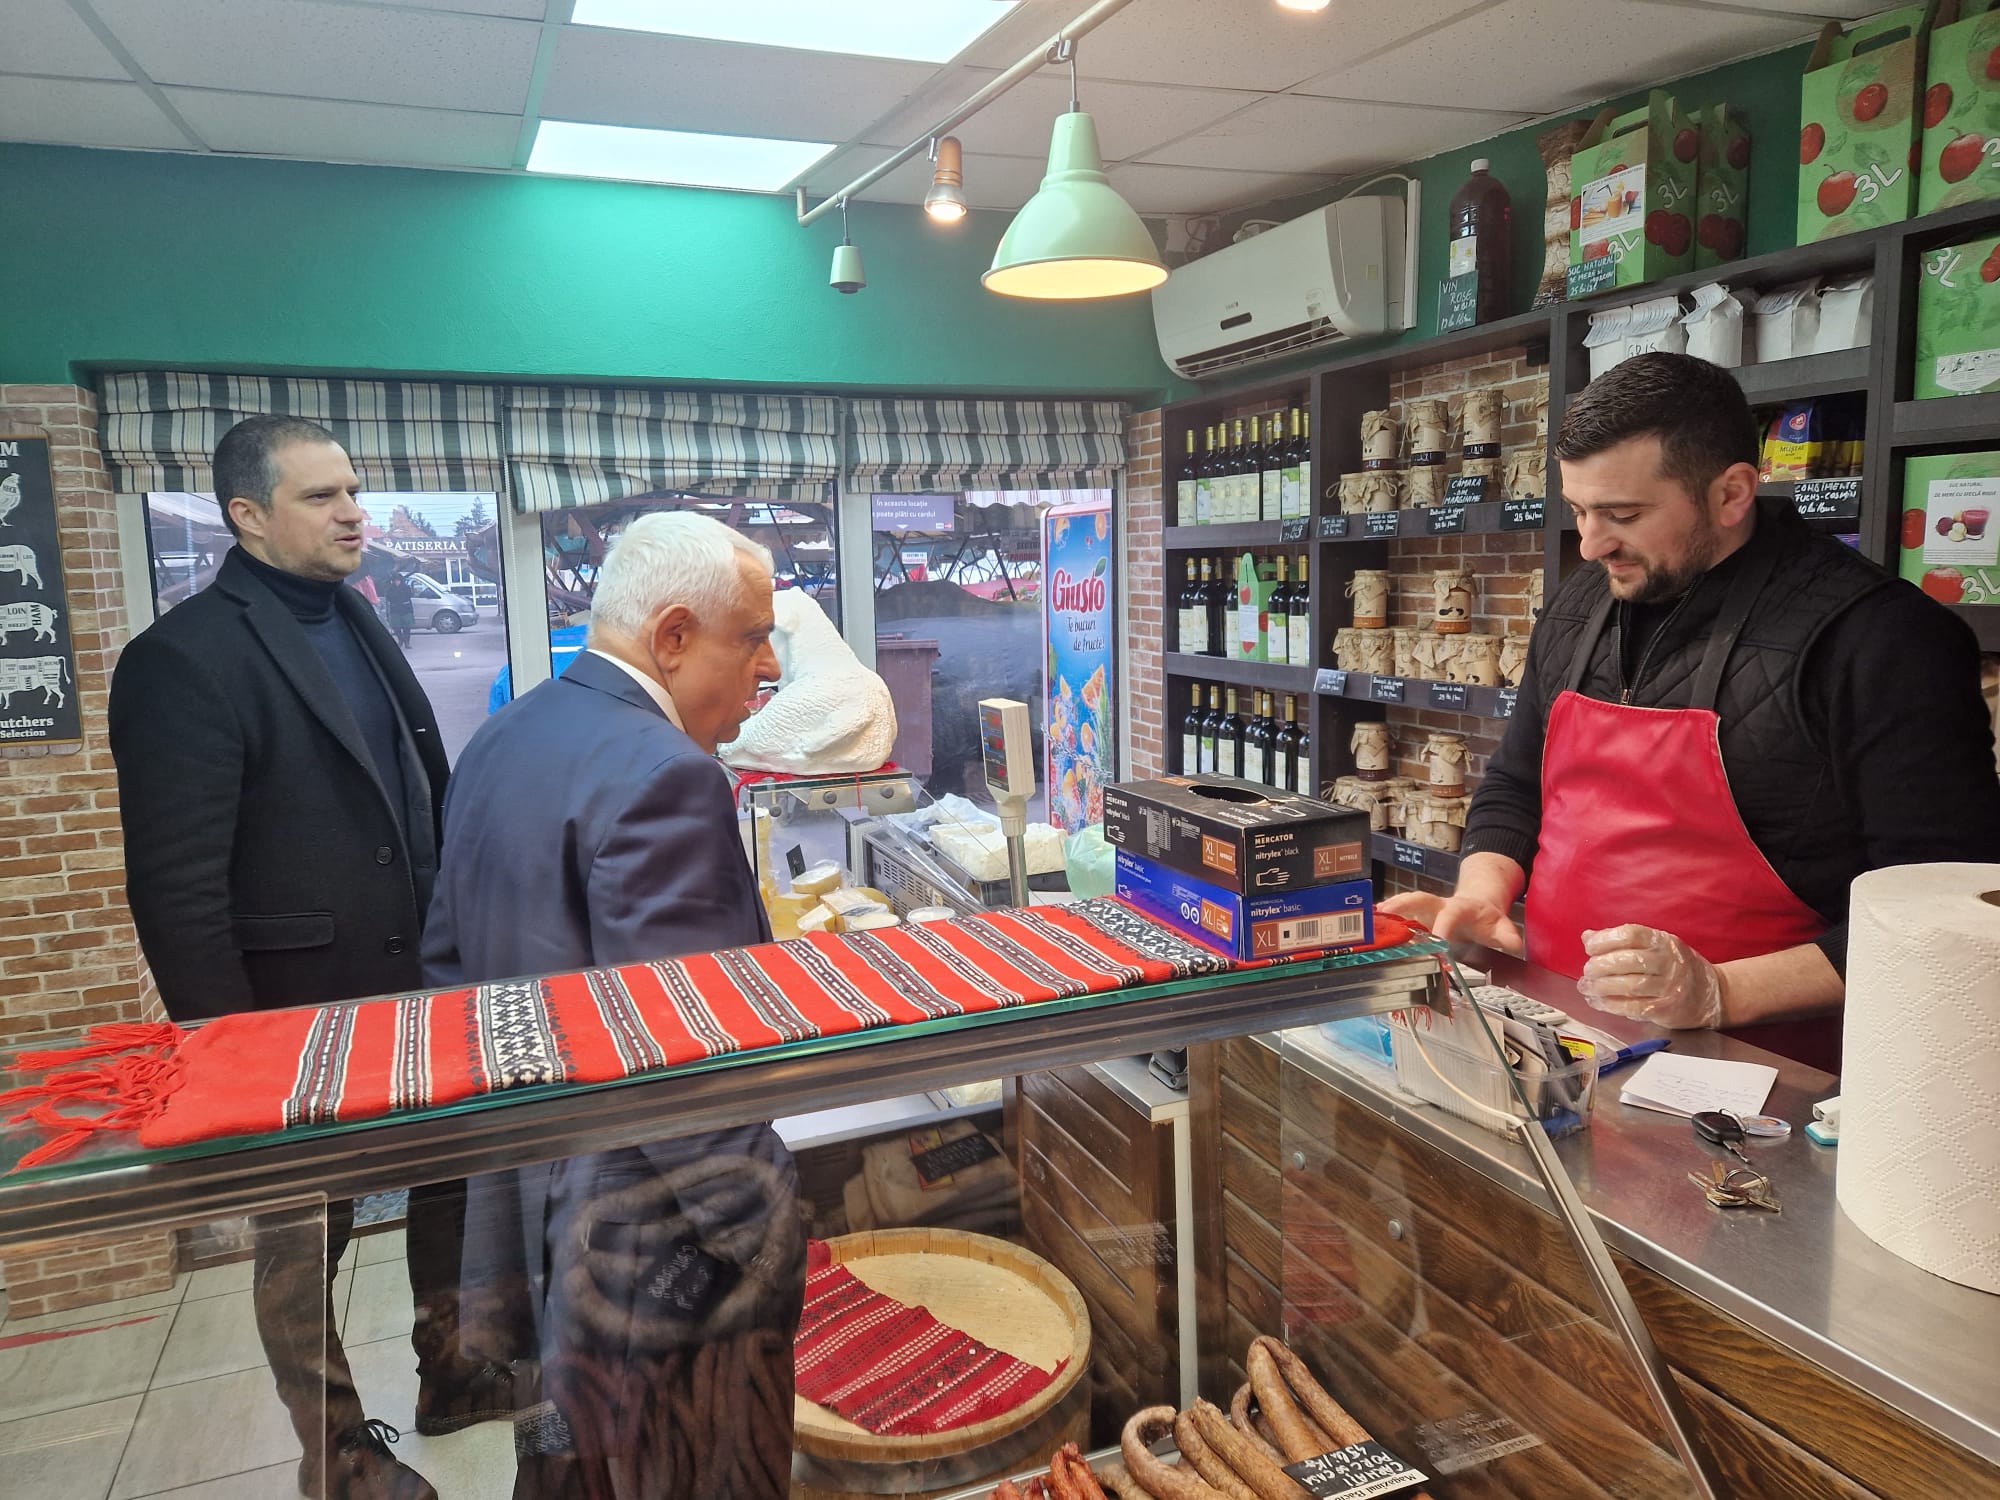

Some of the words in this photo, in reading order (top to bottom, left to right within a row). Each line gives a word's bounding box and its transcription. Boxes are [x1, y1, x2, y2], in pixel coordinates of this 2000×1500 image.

[1853, 163, 1902, 203] 3L
[1657, 177, 1688, 209] 3L
[1711, 183, 1741, 212] 3L
[1568, 265, 1581, 277] SUC
[1584, 255, 1614, 271] NATURAL
[1578, 269, 1597, 281] MERE
[1442, 279, 1458, 294] VIN
[876, 511, 894, 519] poate
[386, 540, 458, 551] PATISERIA
[1052, 567, 1105, 614] Giusto
[7, 607, 27, 616] LOIN
[30, 604, 42, 626] HAM
[1067, 616, 1074, 632] Te
[1074, 616, 1096, 632] bucuri
[1073, 636, 1081, 651] de
[0, 716, 54, 729] utchers
[0, 729, 46, 739] Selection
[1254, 833, 1294, 845] MERCATOR
[1205, 840, 1215, 856] XL
[1255, 849, 1282, 861] nitrylex
[1284, 847, 1300, 857] black
[1318, 851, 1333, 865] XL
[1202, 907, 1214, 926] XL
[1250, 905, 1281, 917] nitrylex
[1283, 903, 1301, 912] basic
[1256, 929, 1276, 949] XL
[1350, 1451, 1392, 1471] PORC
[1367, 1473, 1417, 1494] Magazinul
